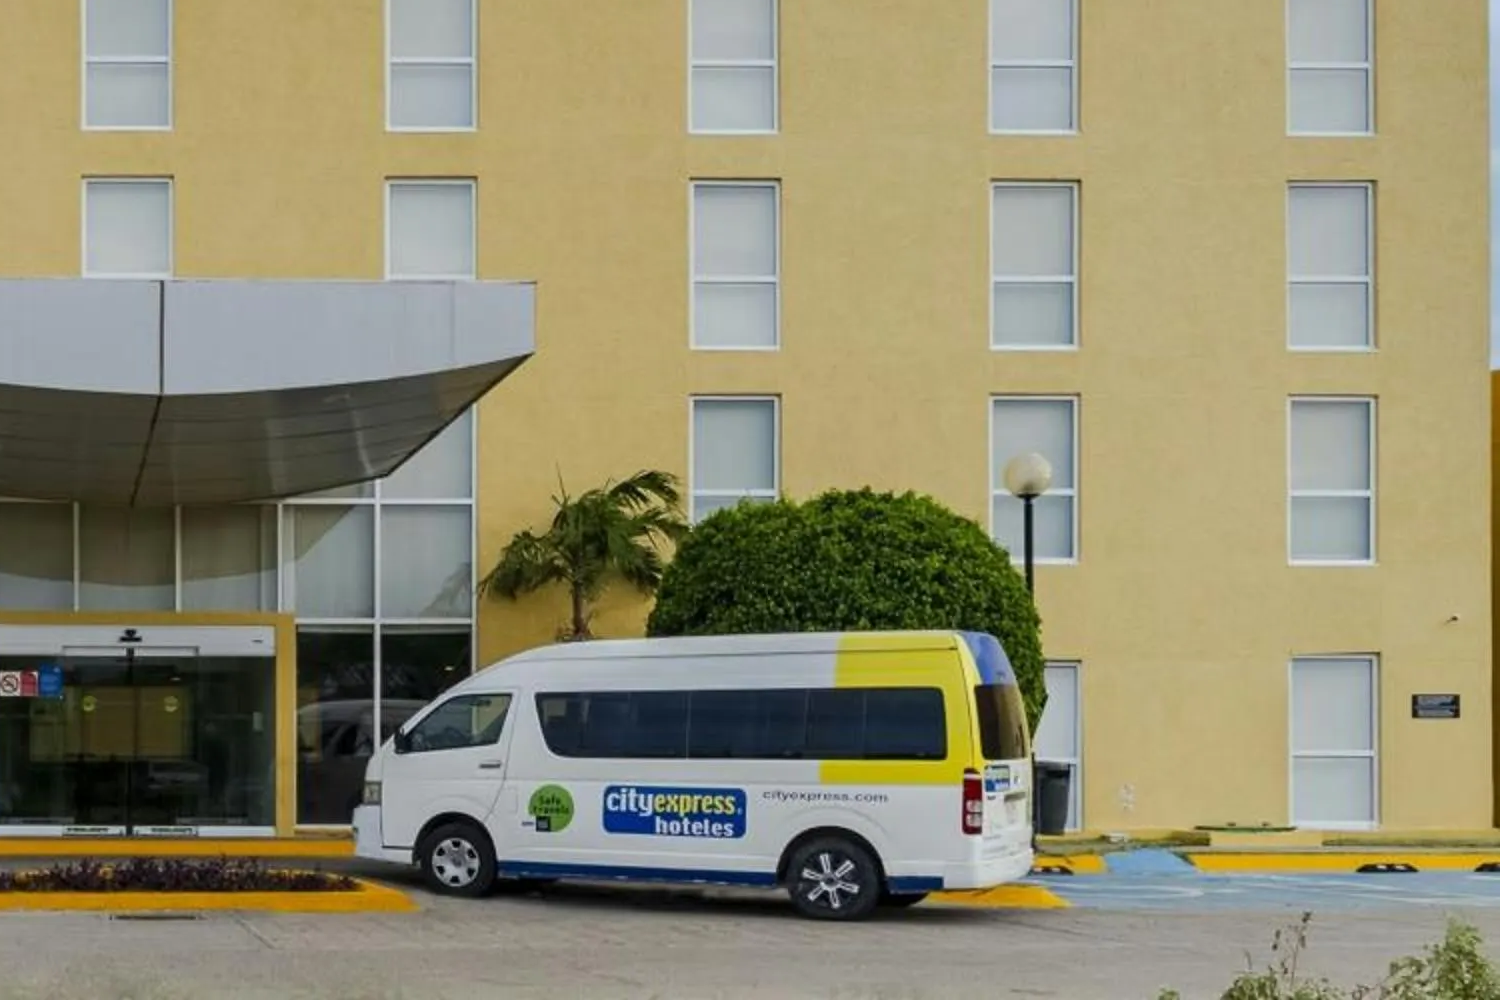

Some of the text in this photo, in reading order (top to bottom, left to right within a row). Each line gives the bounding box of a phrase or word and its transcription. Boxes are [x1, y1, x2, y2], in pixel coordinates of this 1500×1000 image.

[606, 787, 736, 817] cityexpress
[762, 789, 888, 803] cityexpress.com
[654, 815, 734, 837] hoteles
